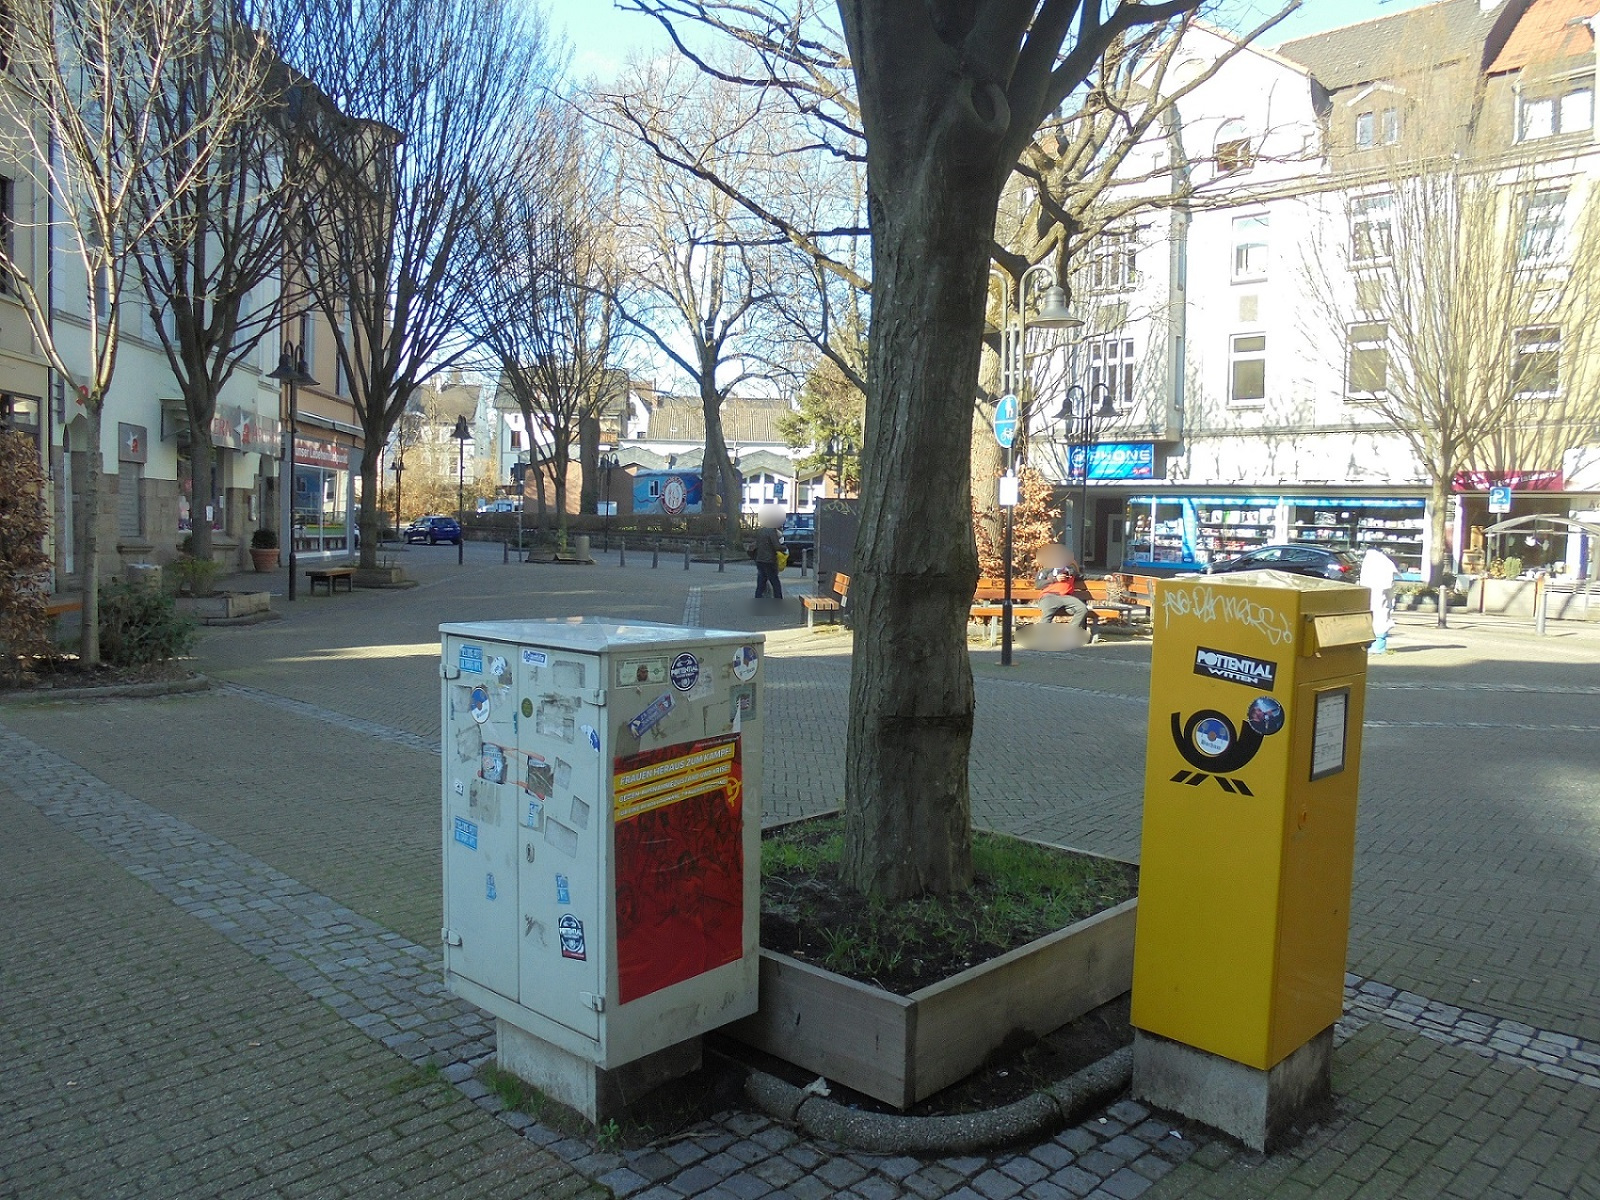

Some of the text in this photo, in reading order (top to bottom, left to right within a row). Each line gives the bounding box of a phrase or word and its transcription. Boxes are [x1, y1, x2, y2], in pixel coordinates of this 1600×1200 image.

[1197, 650, 1273, 679] POTTENTIAL
[1208, 667, 1259, 684] WITTEN
[619, 769, 653, 786] FRAUEN
[653, 761, 686, 777] HERAUS
[686, 755, 703, 767] ZUM
